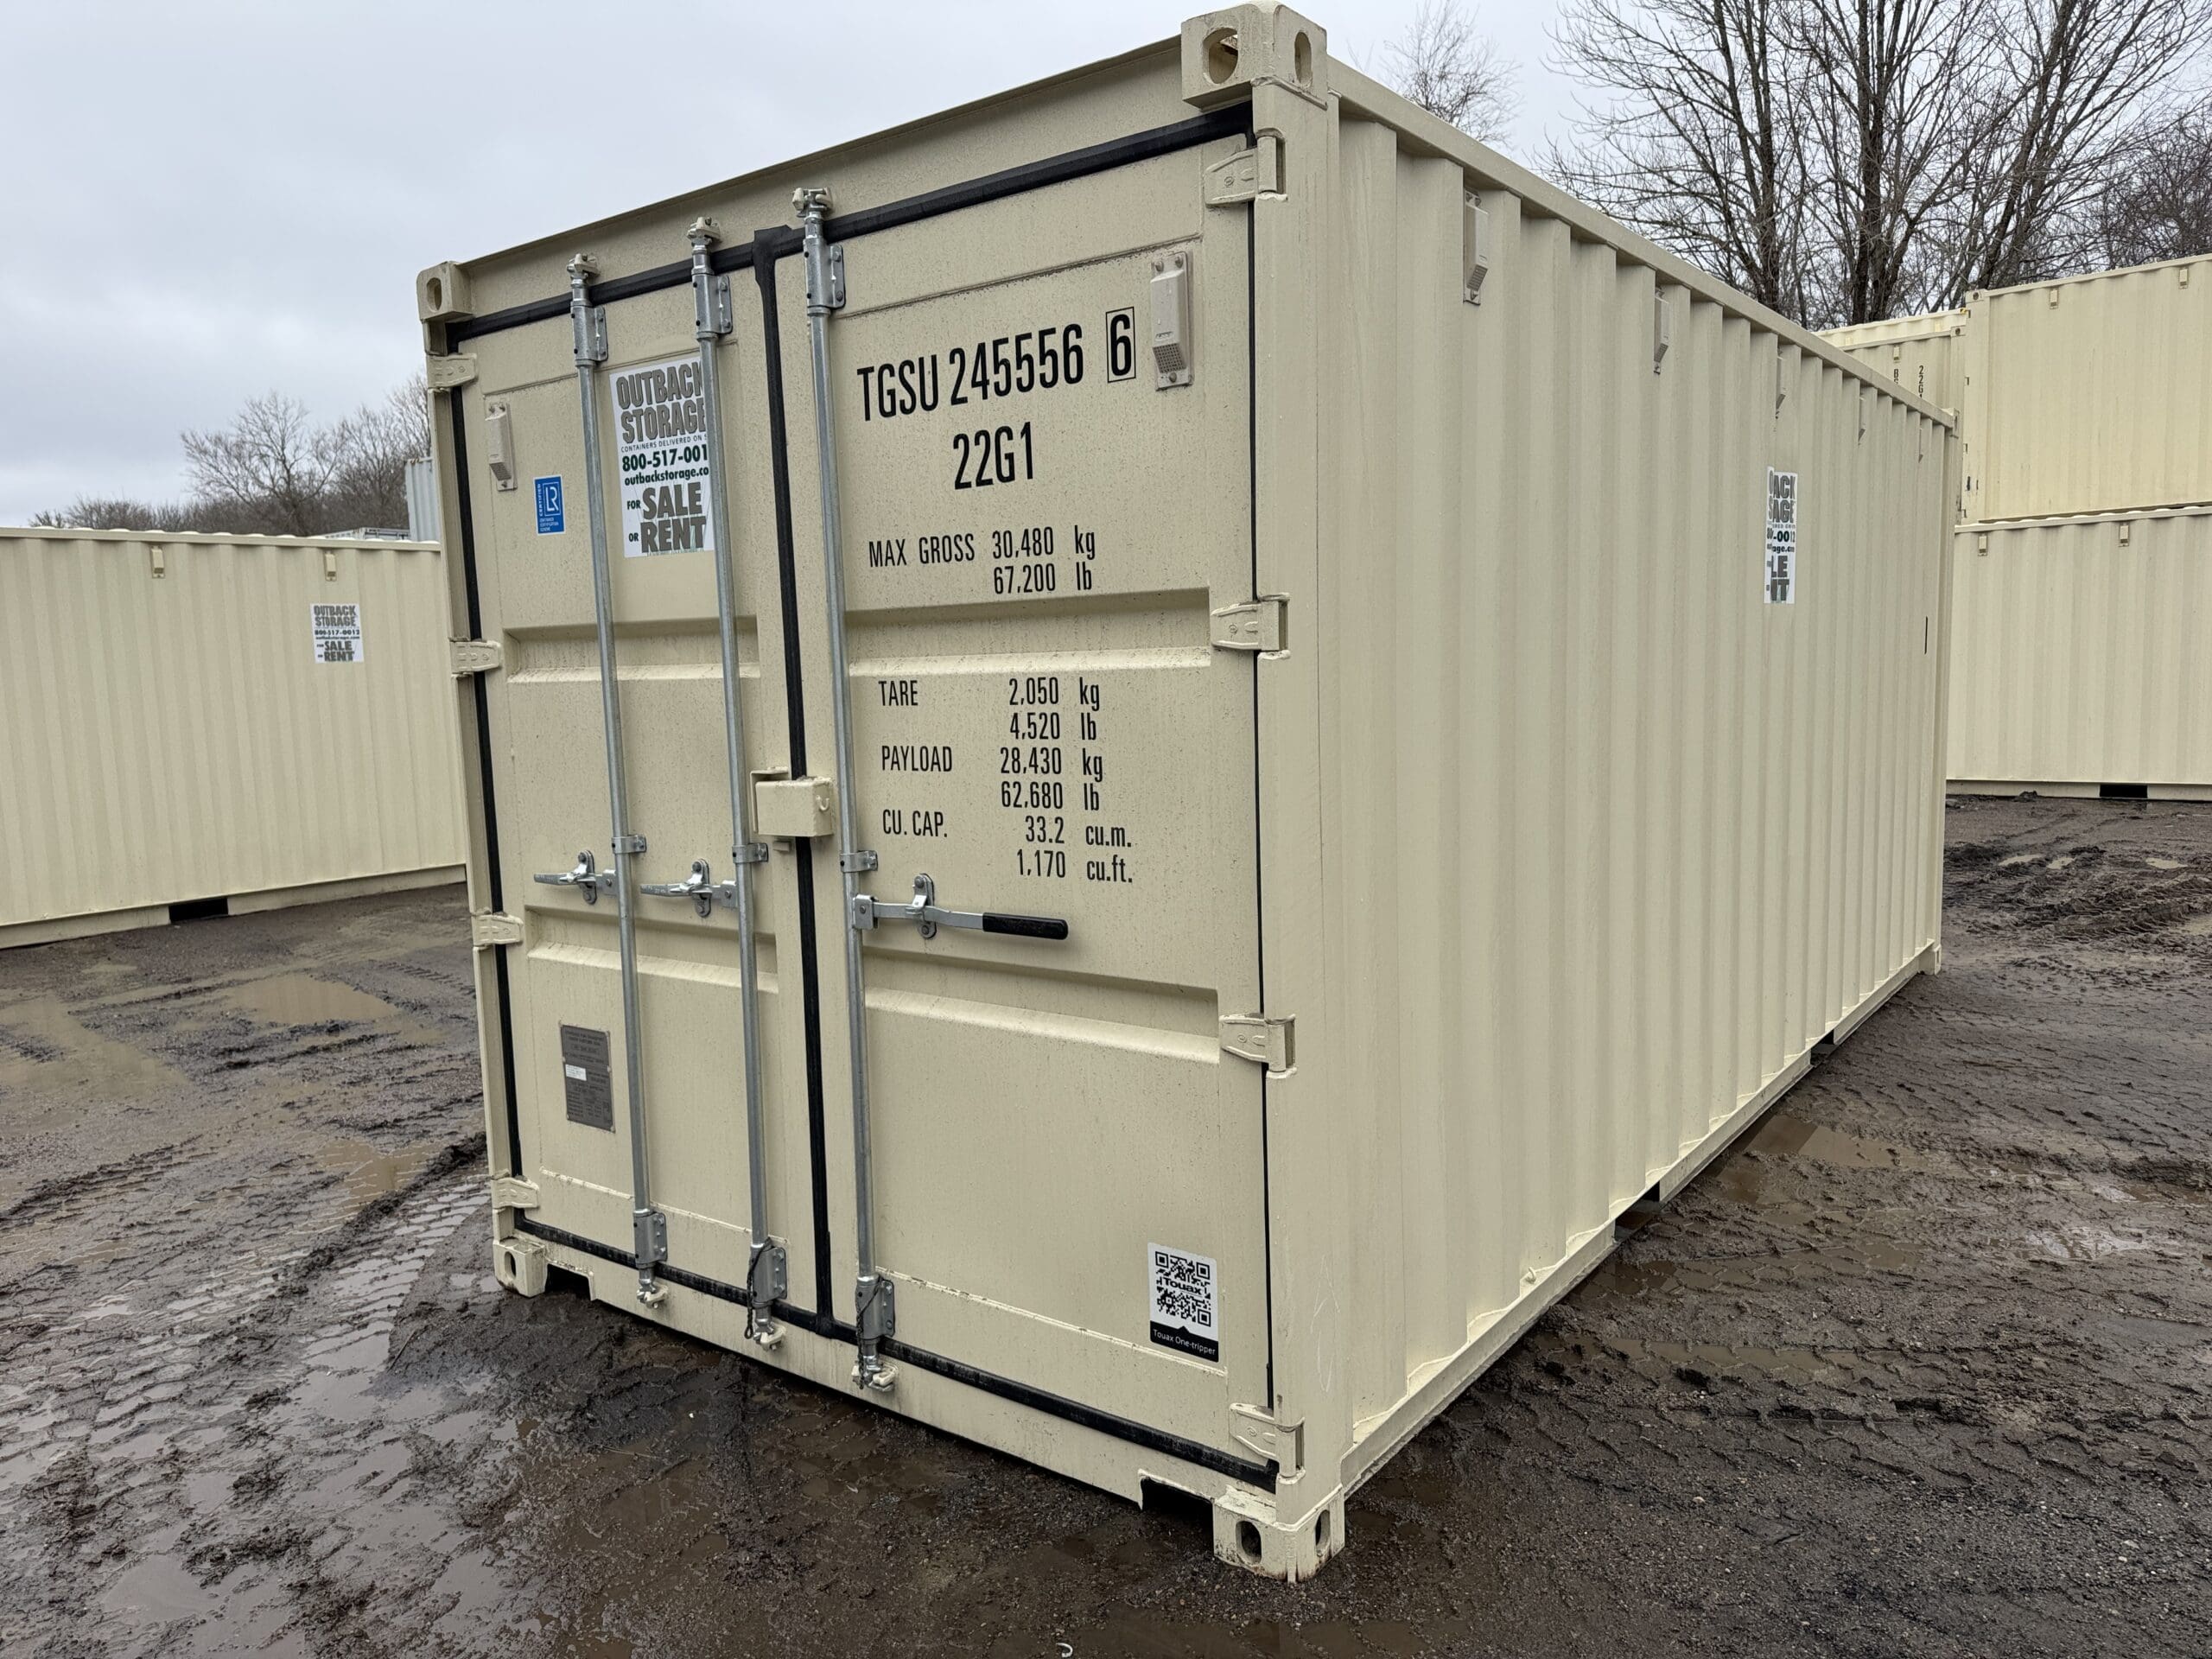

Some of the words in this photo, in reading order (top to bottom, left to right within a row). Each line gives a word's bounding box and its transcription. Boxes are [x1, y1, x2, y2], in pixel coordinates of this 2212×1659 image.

[857, 354, 939, 421] TGSU
[949, 323, 1084, 406] 245556
[1110, 314, 1132, 376] 6
[620, 397, 706, 444] STORAGE
[620, 442, 657, 454] CONTAINERS
[658, 435, 691, 447] DELIVERED
[622, 444, 708, 472] 800-517-001
[952, 422, 1033, 490] 22G1
[625, 467, 709, 486] outbackstorage.co
[627, 500, 641, 510] FOR
[643, 481, 702, 520] SALE
[629, 533, 639, 542] OR
[640, 516, 707, 553] RENT
[868, 538, 907, 568] MAX
[918, 533, 975, 564] GROSS
[992, 526, 1054, 559] 30,480
[1074, 525, 1096, 560] kg
[994, 563, 1056, 594] 67,200
[1076, 562, 1092, 591] lb
[314, 605, 356, 616] OUTBACK
[315, 616, 356, 626] STORAGE
[324, 651, 354, 662] RENT
[325, 640, 353, 651] SALE
[878, 680, 918, 706] TARE
[1009, 677, 1059, 706] 2,050
[1079, 677, 1100, 711] kg
[1009, 712, 1060, 740] 4,520
[1081, 712, 1096, 741] lb
[881, 745, 952, 772] PAYLOAD
[1000, 747, 1062, 775] 28,430
[1082, 747, 1103, 782] kg
[1001, 781, 1063, 810] 62,680
[1084, 783, 1099, 810] lb
[1026, 816, 1065, 844] 33.2
[1085, 824, 1132, 848] cu.m.
[1017, 849, 1066, 878] 1,170
[1087, 855, 1133, 883] cu.ft.
[1163, 1277, 1202, 1295] Touax
[1153, 1329, 1174, 1343] Touax
[1175, 1336, 1216, 1356] One-tripper
